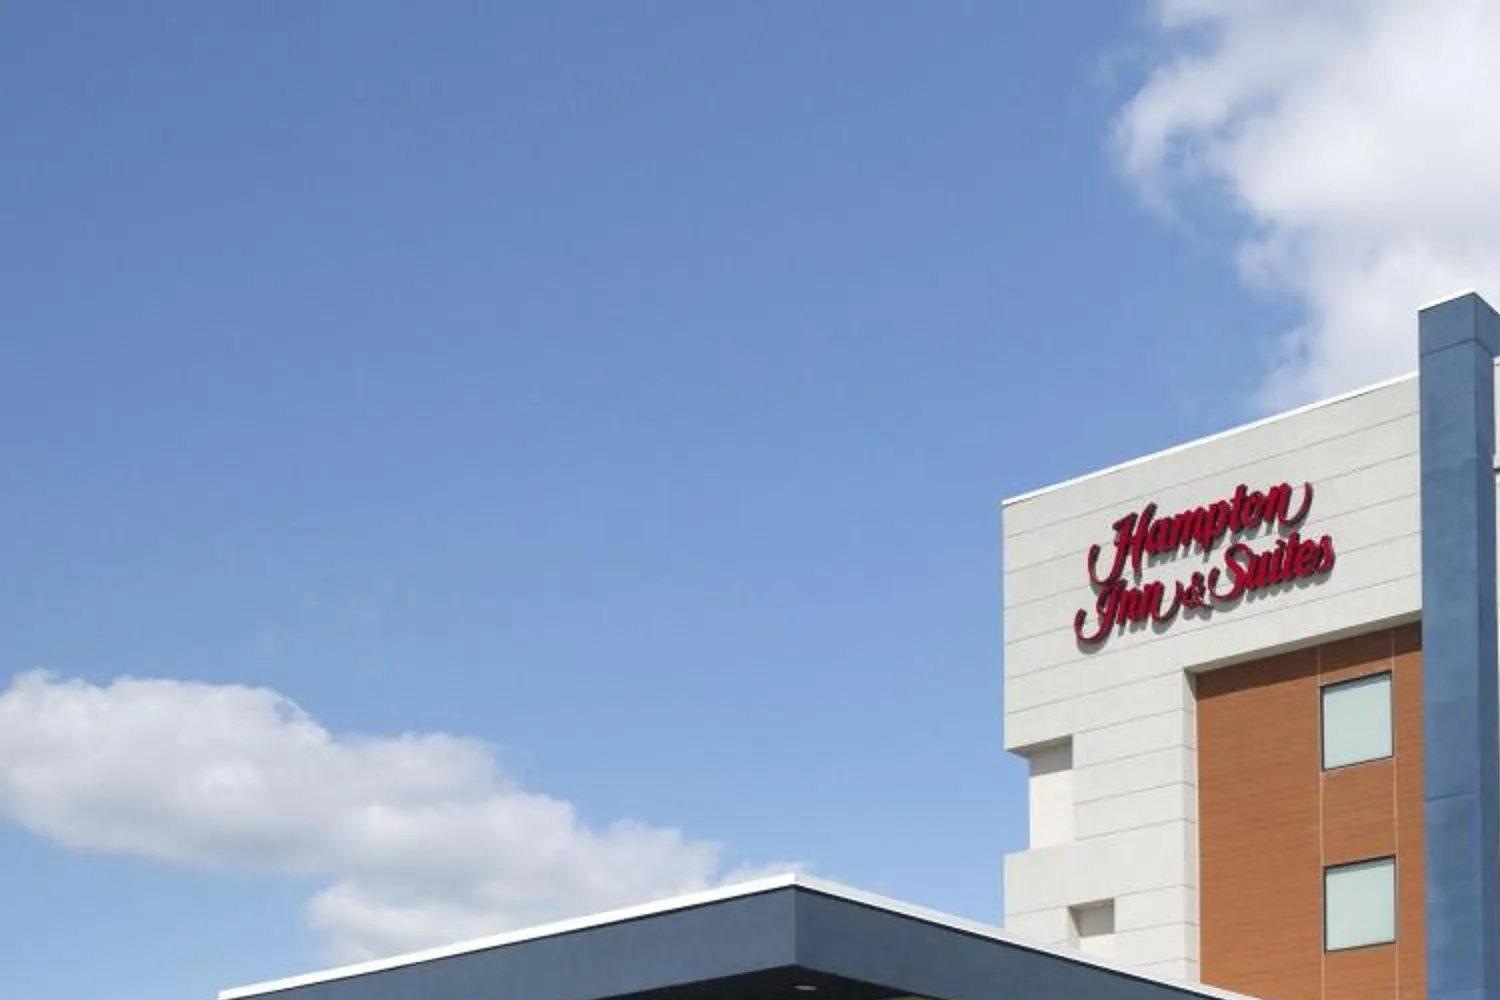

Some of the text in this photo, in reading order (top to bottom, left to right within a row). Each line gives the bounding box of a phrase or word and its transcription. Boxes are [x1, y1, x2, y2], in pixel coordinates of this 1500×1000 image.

[1074, 578, 1181, 644] Inn
[1208, 531, 1335, 600] Suites
[1088, 482, 1313, 585] Hampton
